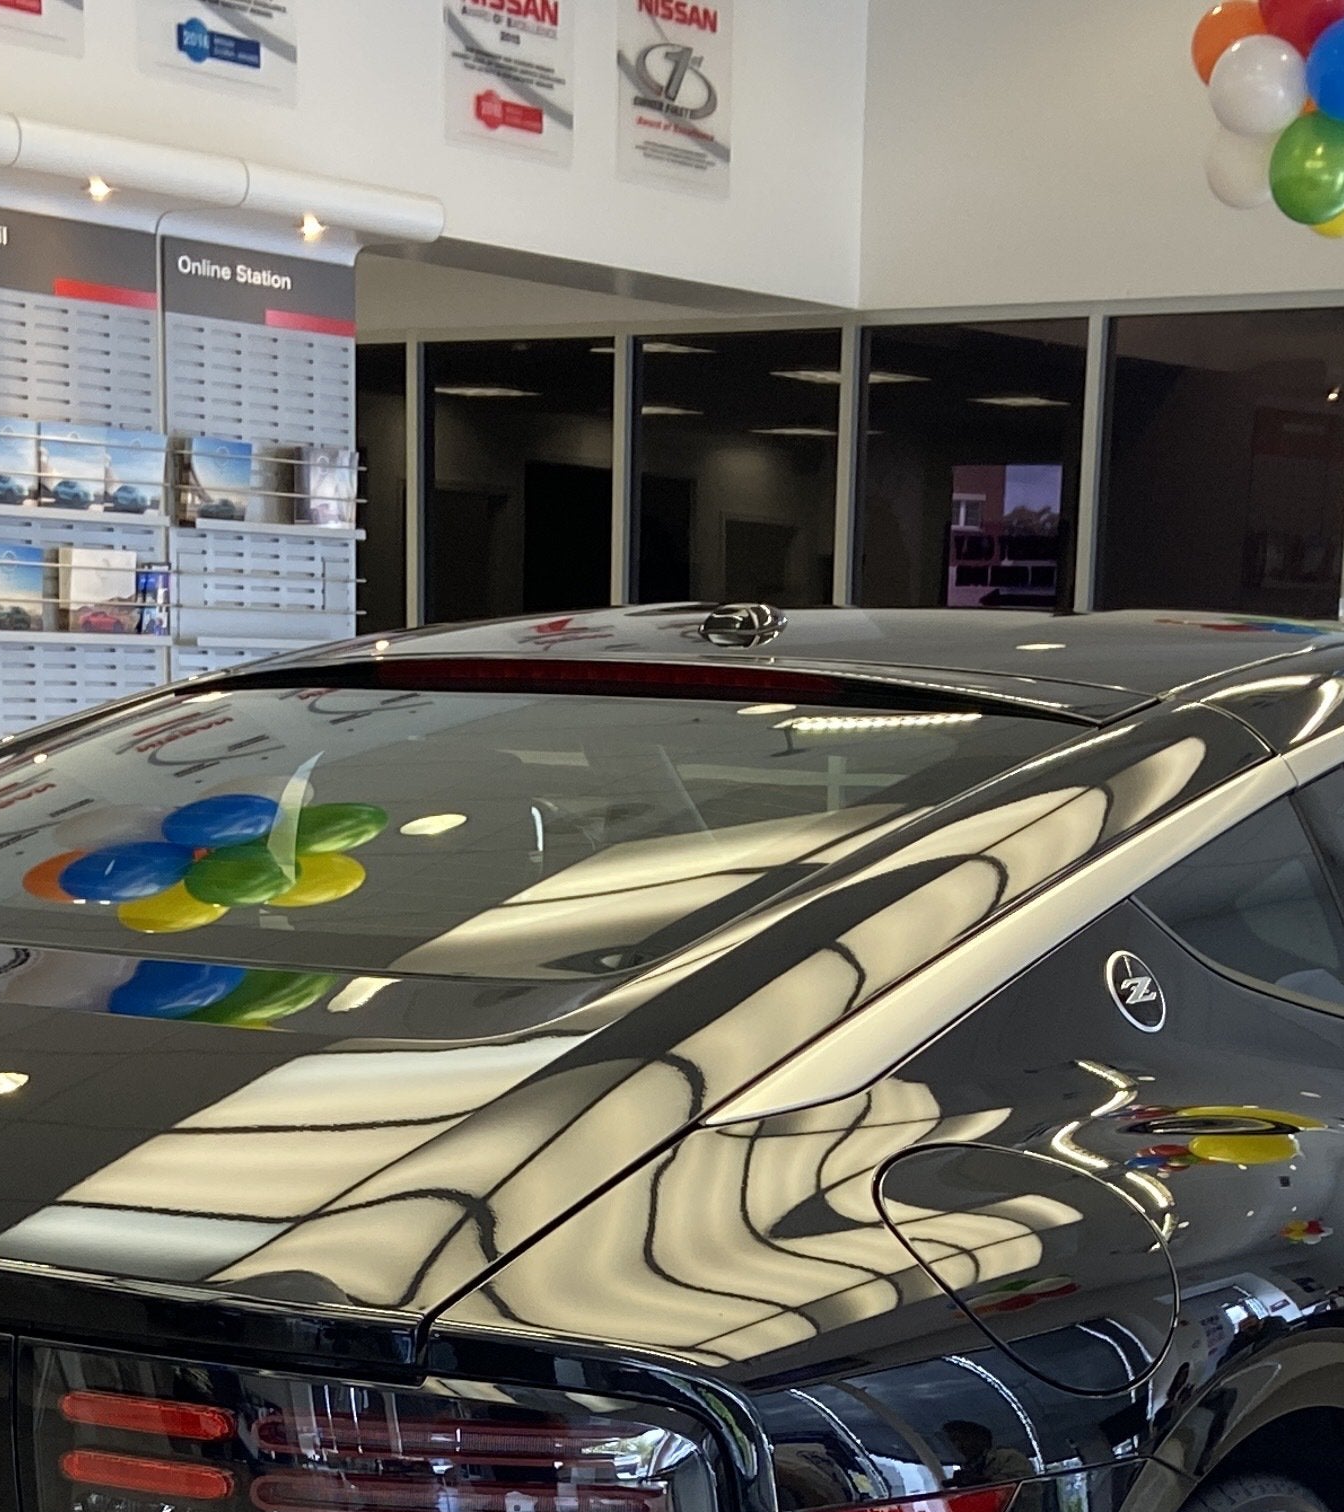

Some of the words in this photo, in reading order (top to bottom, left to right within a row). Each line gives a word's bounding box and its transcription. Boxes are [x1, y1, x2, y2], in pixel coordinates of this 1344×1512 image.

[459, 0, 558, 26] SAN
[178, 255, 232, 281] Online
[236, 265, 292, 291] Station
